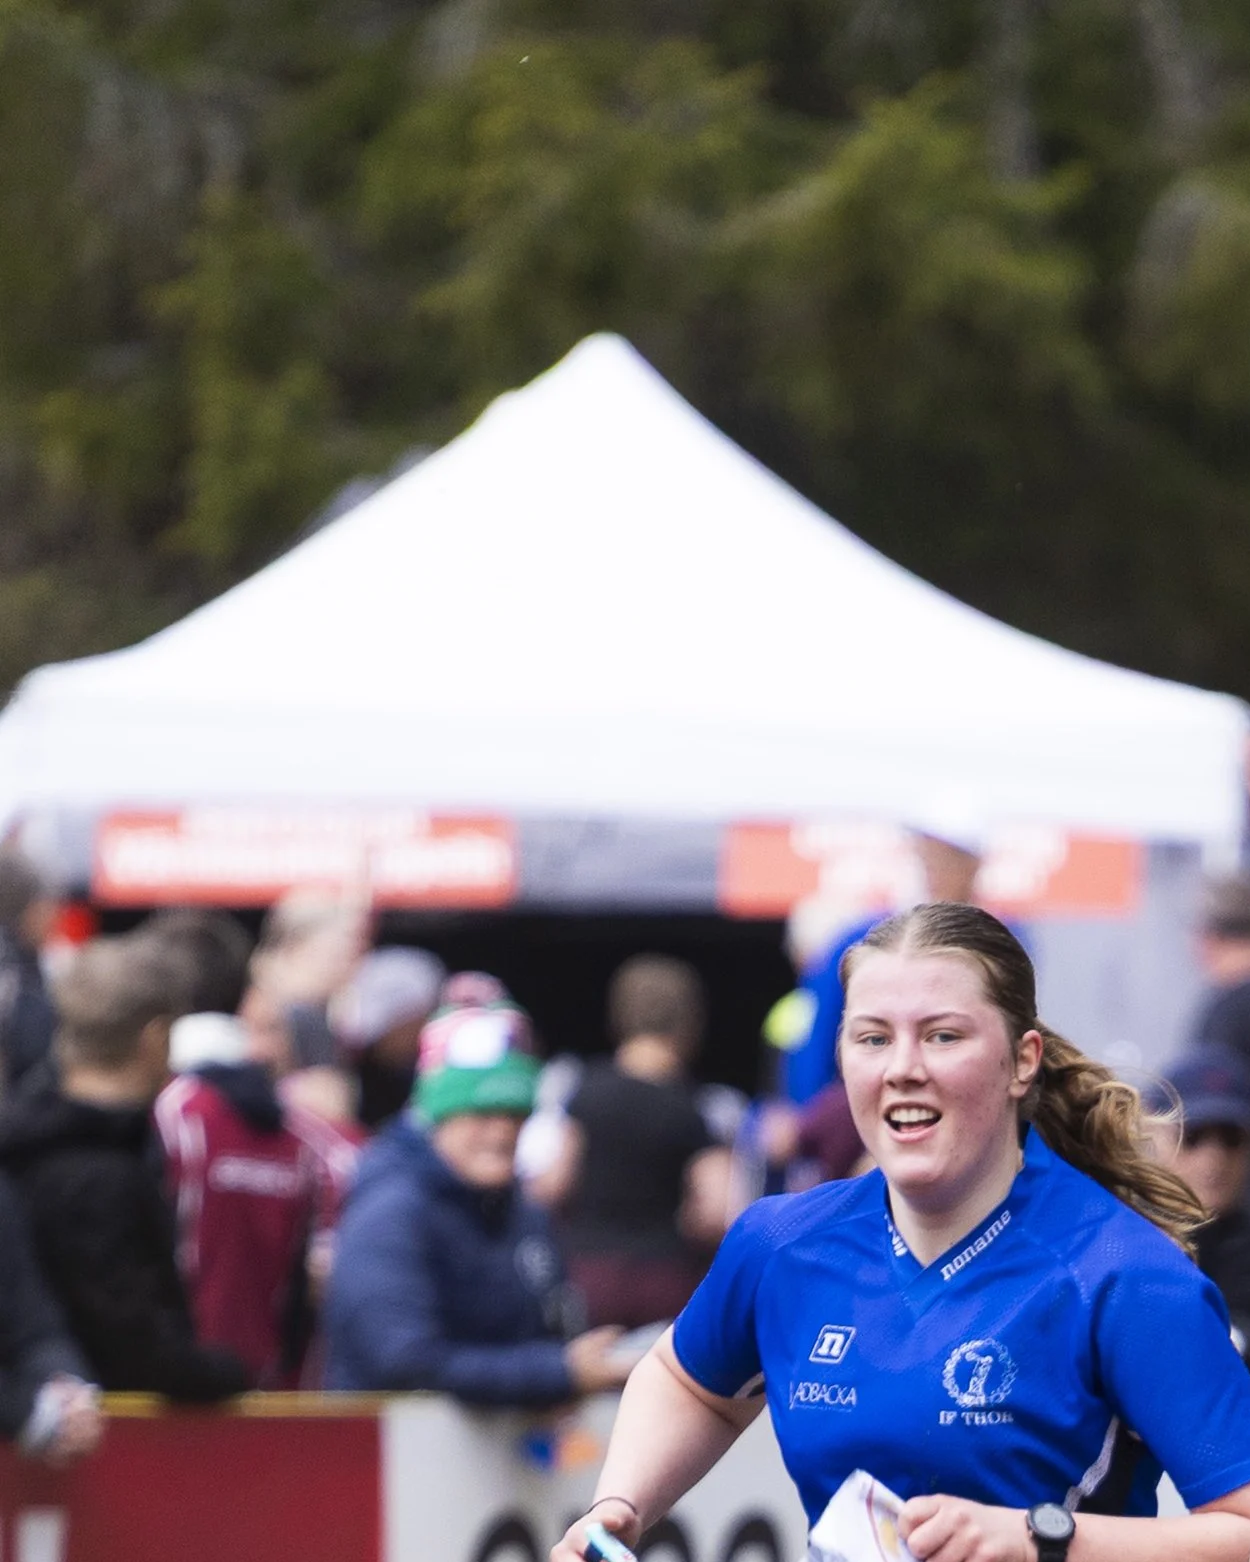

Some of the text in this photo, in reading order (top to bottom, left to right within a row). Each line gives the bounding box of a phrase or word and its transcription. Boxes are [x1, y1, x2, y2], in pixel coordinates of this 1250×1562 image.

[940, 1209, 1011, 1281] noname
[938, 1410, 1014, 1426] IF THOR
